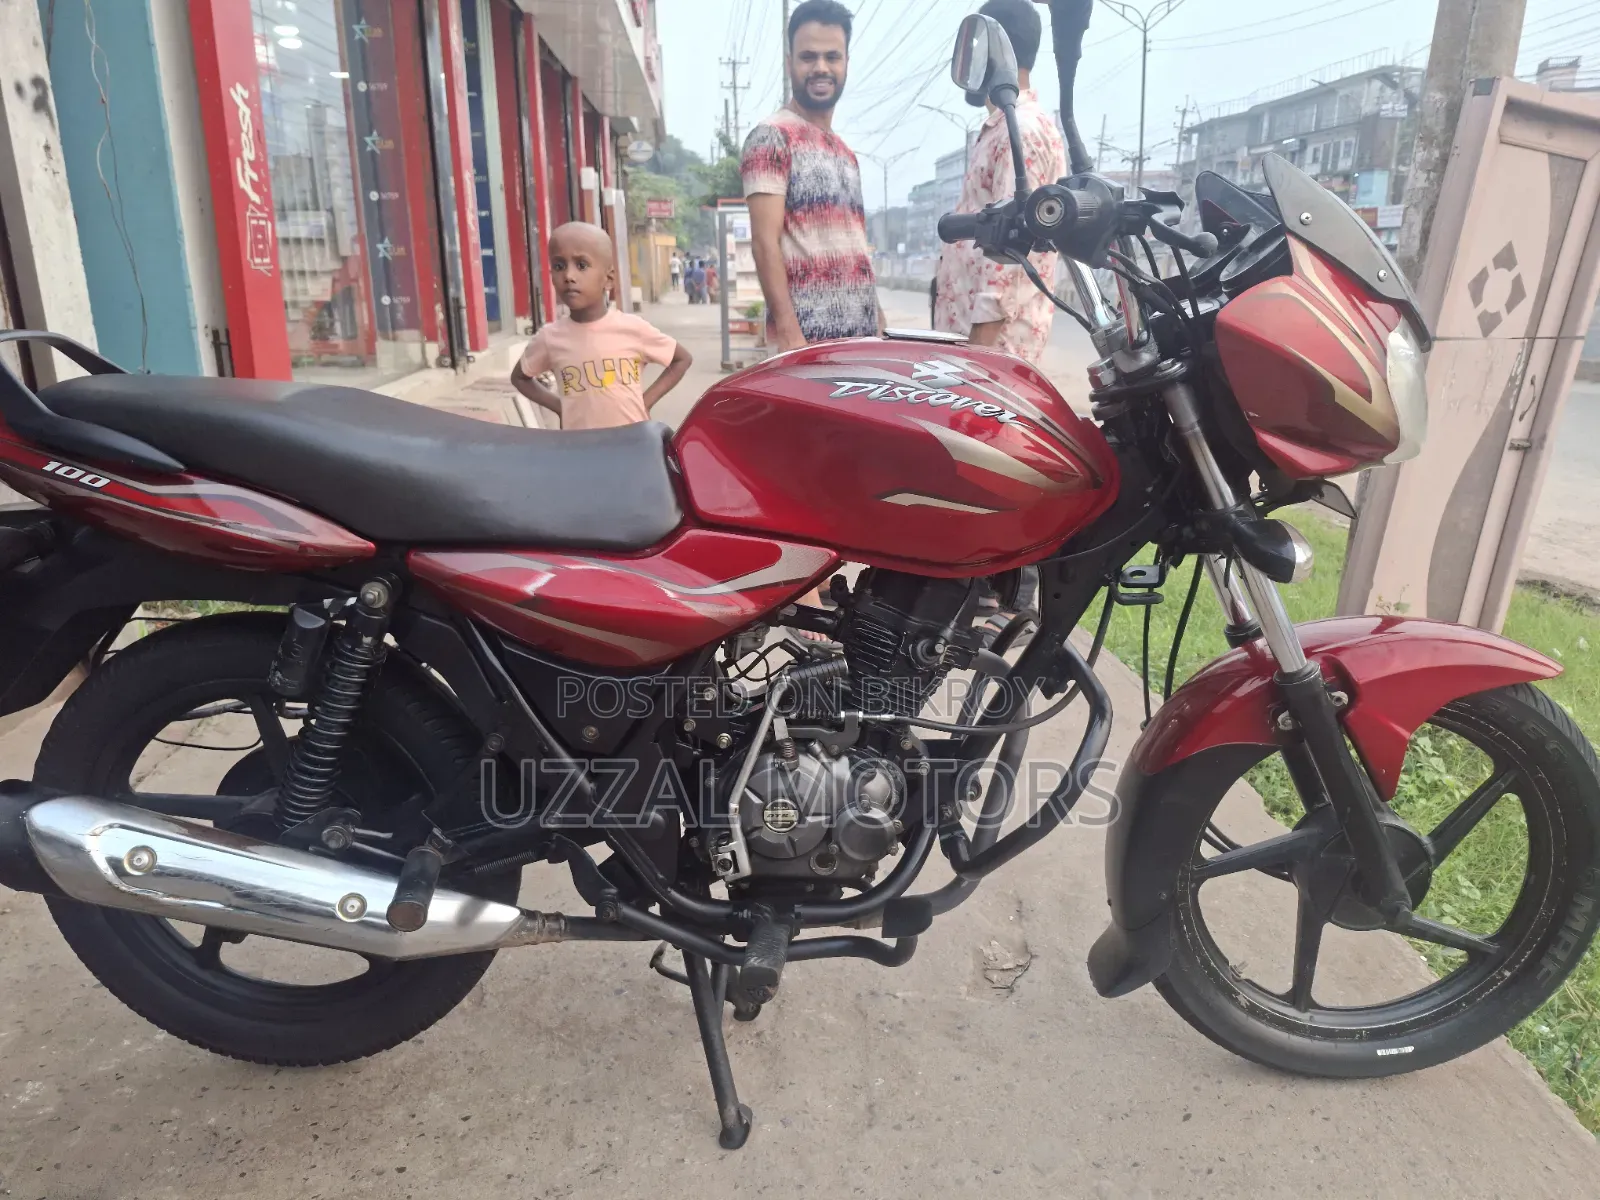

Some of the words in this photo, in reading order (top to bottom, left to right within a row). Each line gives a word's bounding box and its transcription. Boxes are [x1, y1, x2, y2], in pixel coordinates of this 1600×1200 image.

[229, 82, 261, 205] Fresh
[561, 357, 641, 396] RUN
[828, 380, 1037, 431] Discover
[42, 460, 111, 488] 100
